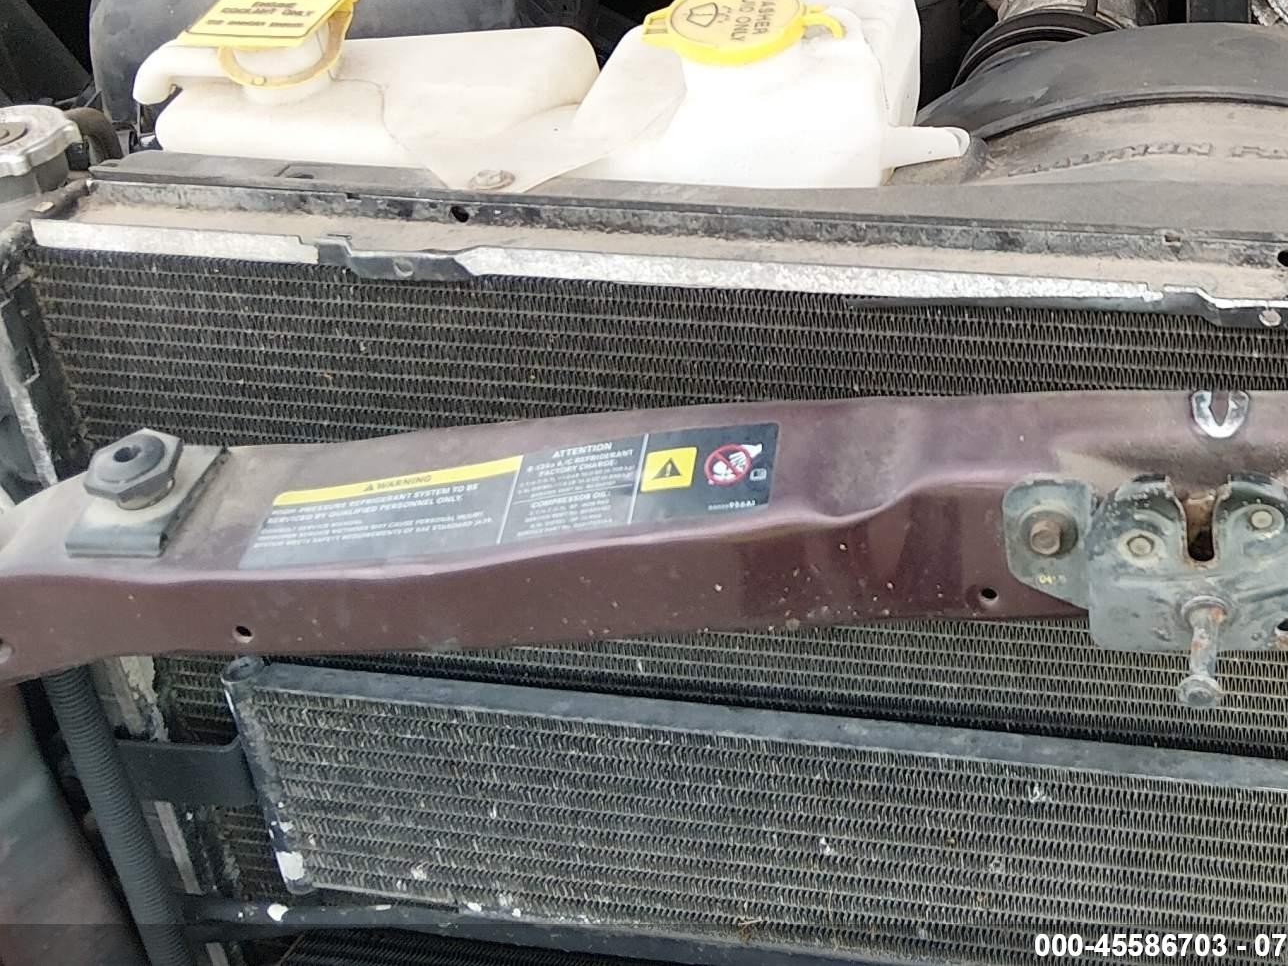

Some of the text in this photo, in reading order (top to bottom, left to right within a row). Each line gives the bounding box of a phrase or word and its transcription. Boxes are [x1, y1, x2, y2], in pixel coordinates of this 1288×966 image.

[731, 16, 750, 42] ONLY
[551, 441, 613, 459] ATTENTION
[377, 475, 433, 491] WARNING
[413, 487, 451, 498] SYSTEM
[452, 485, 464, 493] TO
[380, 499, 434, 511] PERSONNEL
